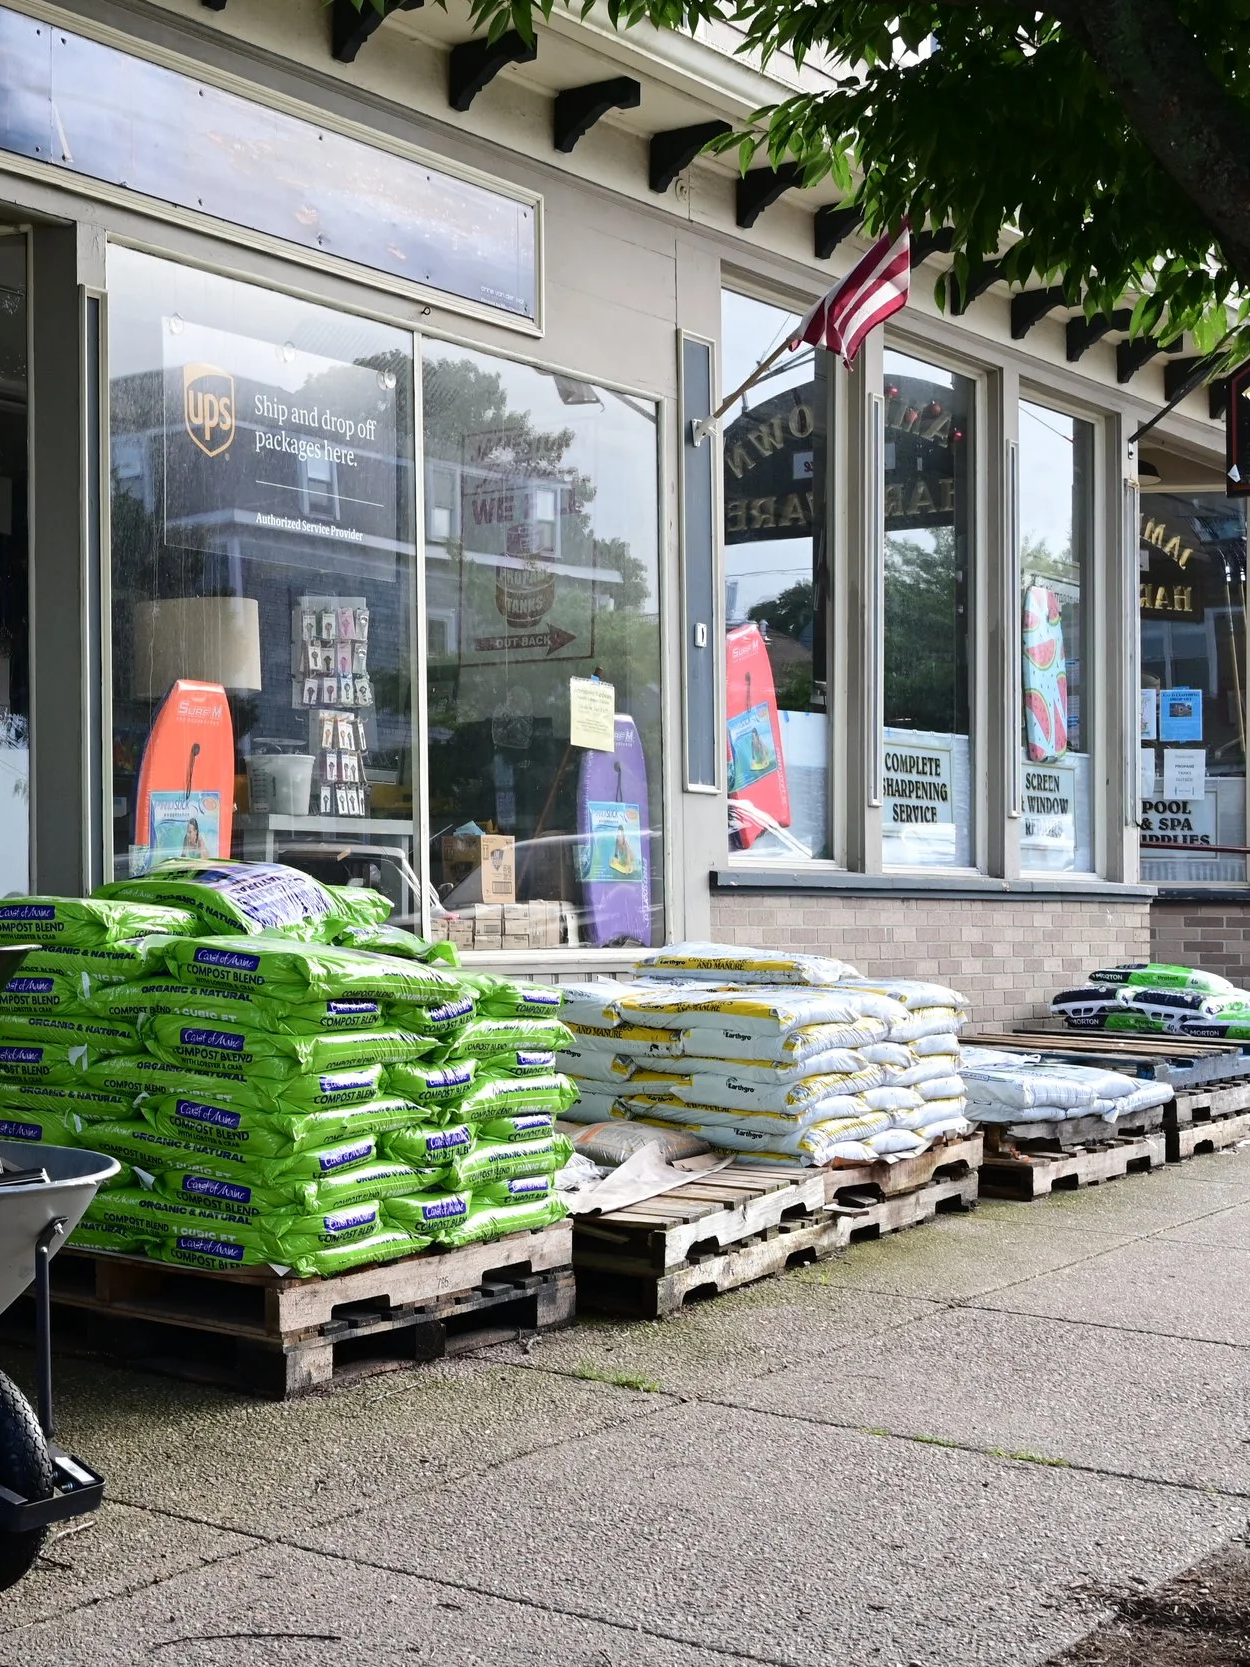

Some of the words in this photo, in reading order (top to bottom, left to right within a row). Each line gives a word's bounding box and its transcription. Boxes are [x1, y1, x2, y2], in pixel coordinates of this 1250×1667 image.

[188, 389, 231, 440] ups
[255, 394, 287, 425] Ship
[291, 406, 318, 427] and
[321, 411, 354, 440] drop
[357, 420, 377, 440] off
[255, 430, 321, 462] packages
[324, 440, 358, 466] here.
[255, 512, 301, 531] Authorized
[302, 518, 330, 535] Service
[330, 522, 363, 542] Provider
[505, 597, 543, 614] TANKS
[496, 636, 518, 648] OUT
[521, 635, 552, 647] BACK
[885, 753, 941, 777] COMPLETE
[1025, 772, 1060, 793] SCREEN
[893, 803, 937, 823] SERVICE
[1027, 795, 1069, 815] WINDOW
[1141, 800, 1191, 815] POOL
[1158, 817, 1193, 831] SPA
[0, 907, 19, 918] Coast
[20, 906, 28, 918] of
[28, 906, 51, 917] Maine
[35, 922, 65, 932] BLEND
[197, 949, 218, 963] Coast
[220, 952, 227, 964] of
[227, 952, 254, 968] Maine
[697, 962, 713, 970] AND
[714, 962, 745, 971] MANURE
[186, 964, 230, 980] COMPOST
[233, 972, 266, 986] BLEND
[1096, 973, 1123, 981] MORTON
[32, 995, 61, 1005] BLEND
[142, 984, 188, 994] ORGANIC
[190, 987, 198, 995] &
[199, 988, 253, 1002] NATURAL
[109, 1006, 148, 1015] COMPOST
[149, 1006, 171, 1015] BLEND
[182, 1008, 218, 1020] CUBIC
[221, 1014, 238, 1023] FT
[320, 1016, 360, 1027] COMPOST
[1071, 1018, 1099, 1026] MORTON
[28, 1018, 75, 1031] ORGANIC
[76, 1024, 83, 1032] &
[85, 1025, 132, 1039] NATURAL
[576, 1026, 592, 1035] AND
[593, 1028, 623, 1039] MANURE
[724, 1032, 752, 1041] Earthgro
[1190, 1029, 1220, 1037] MORTON
[184, 1030, 206, 1044] Coast
[208, 1031, 215, 1044] of
[215, 1032, 240, 1048] Maine
[172, 1046, 219, 1061] COMPOST
[220, 1051, 253, 1063] BLEND
[22, 1063, 50, 1075] BLEND
[19, 1086, 66, 1098] ORGANIC
[77, 1092, 123, 1103] NATURAL
[103, 1079, 143, 1091] COMPOST
[144, 1083, 166, 1094] BLEND
[418, 1088, 453, 1100] COMPOST
[728, 1083, 755, 1093] Earthgro
[313, 1090, 356, 1105] COMPOST
[180, 1102, 201, 1117] Coast
[203, 1108, 211, 1120] of
[211, 1110, 235, 1126] Maine
[169, 1115, 213, 1136] COMPOST
[216, 1127, 250, 1141] BLEND
[735, 1128, 763, 1139] Earthgro
[99, 1143, 139, 1158] COMPOST
[139, 1152, 164, 1165] BLEND
[132, 1131, 182, 1149] ORGANIC
[183, 1142, 191, 1150] &
[192, 1144, 247, 1164] NATURAL
[186, 1177, 209, 1192] Coast
[209, 1181, 217, 1194] of
[217, 1182, 245, 1200] Maine
[176, 1190, 223, 1209] COMPOST
[225, 1202, 261, 1217] BLEND
[139, 1200, 187, 1214] ORGANIC
[188, 1208, 196, 1216] &
[198, 1209, 253, 1225] NATURAL
[103, 1212, 146, 1227] COMPOST
[146, 1220, 169, 1233] BLEND
[180, 1226, 217, 1239] CUBIC
[219, 1233, 238, 1243] FT
[415, 1220, 452, 1232] COMPOST
[170, 1249, 217, 1268] COMPOST
